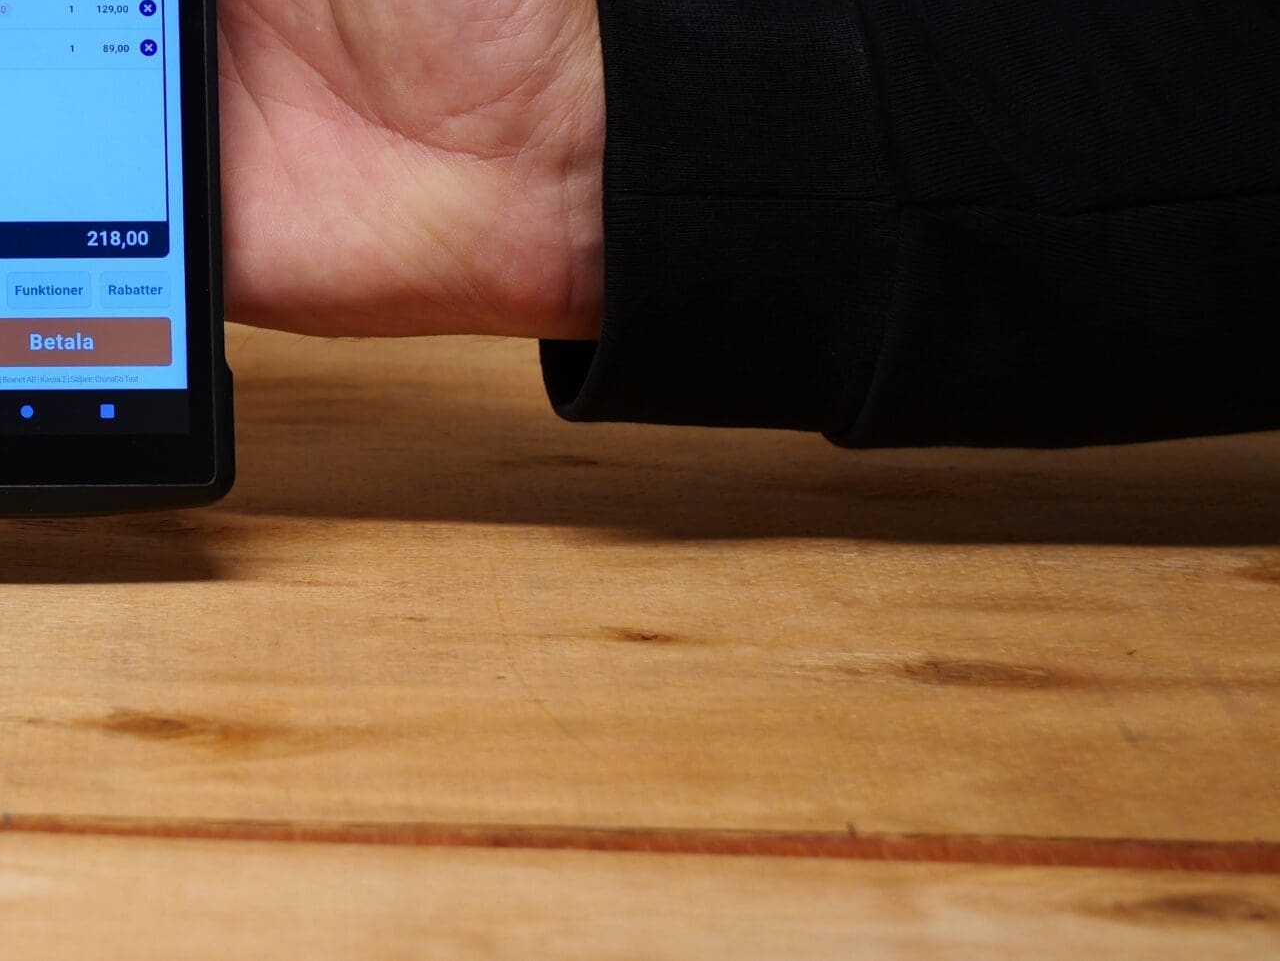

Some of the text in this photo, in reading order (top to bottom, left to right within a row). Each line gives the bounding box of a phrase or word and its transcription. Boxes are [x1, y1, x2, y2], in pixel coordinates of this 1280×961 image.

[69, 5, 74, 14] 1
[96, 4, 129, 15] 129,00
[69, 44, 75, 53] 1
[102, 44, 130, 55] 89,00
[86, 230, 150, 249] 218,00
[14, 284, 84, 296] Funktioner
[108, 284, 164, 296] Rabatter
[30, 332, 94, 351] Betala
